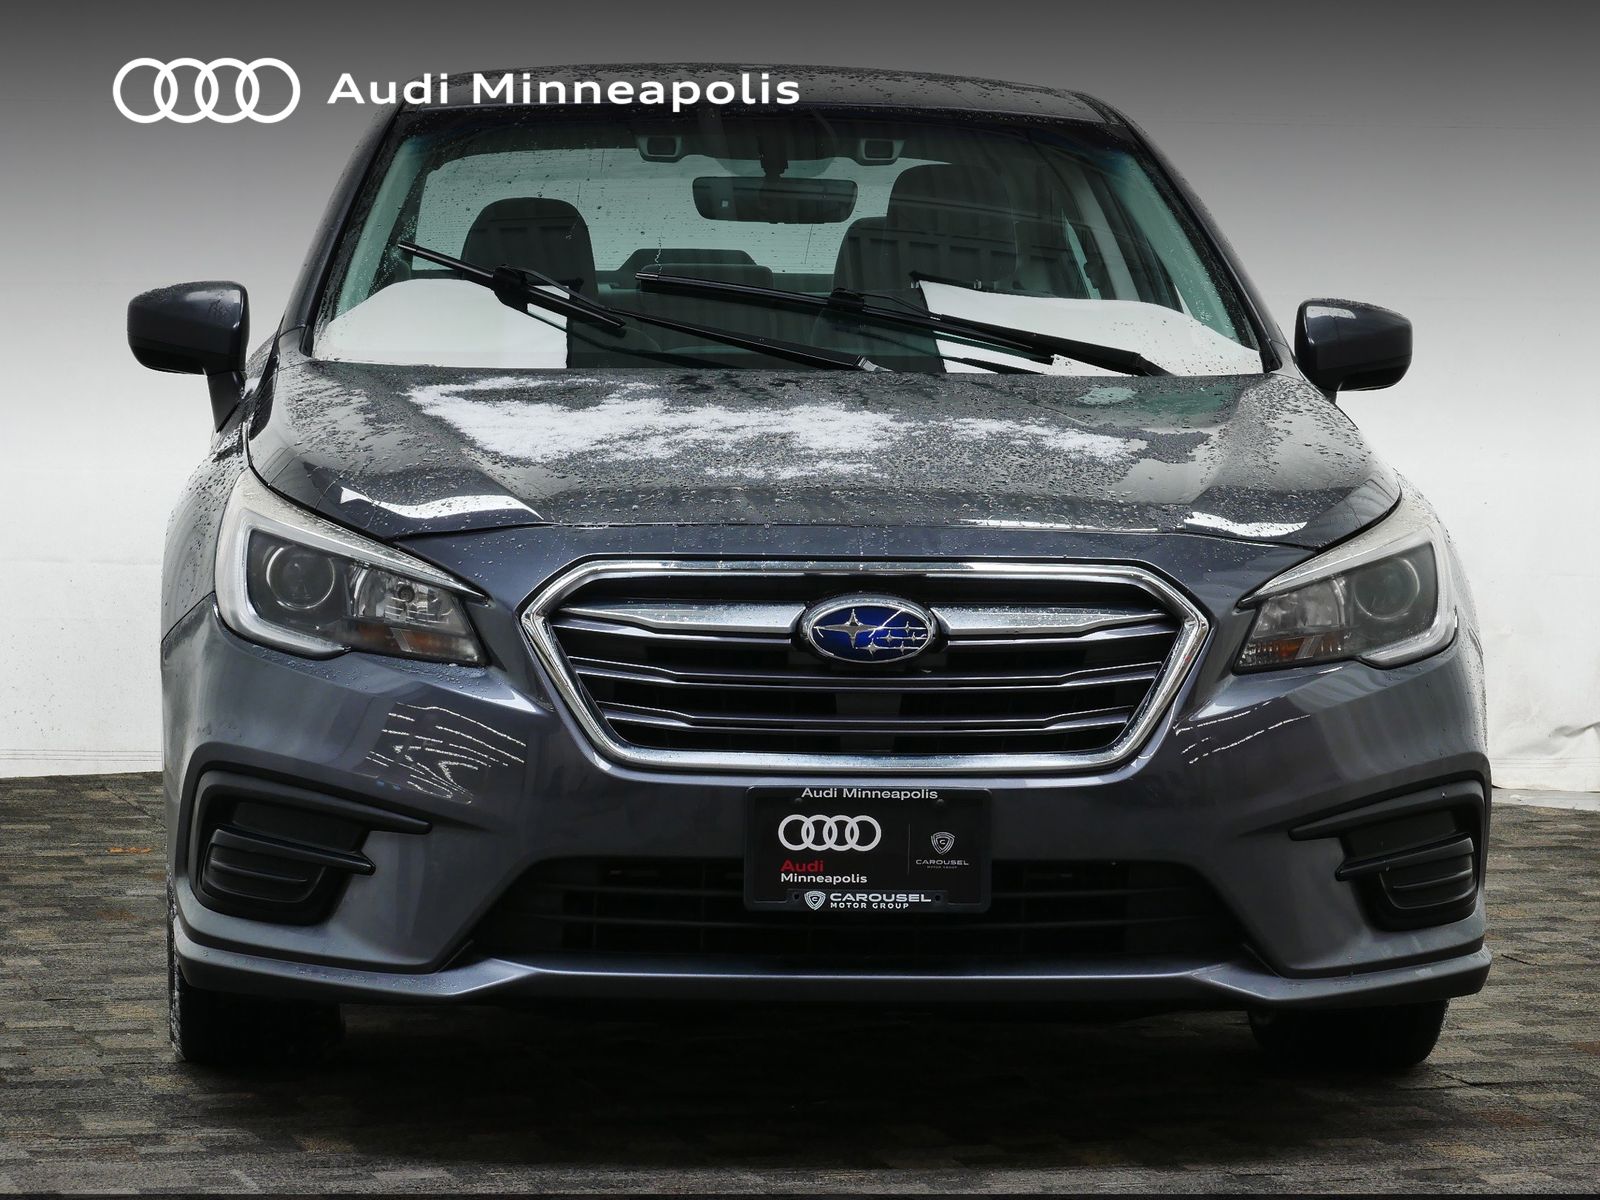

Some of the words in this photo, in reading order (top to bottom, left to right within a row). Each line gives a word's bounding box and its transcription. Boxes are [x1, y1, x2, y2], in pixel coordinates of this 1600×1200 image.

[801, 787, 837, 799] Audi
[842, 788, 938, 801] Minneapolis
[780, 859, 824, 872] Audi
[780, 873, 868, 885] Minneapolis
[829, 893, 932, 902] CAROUSEL
